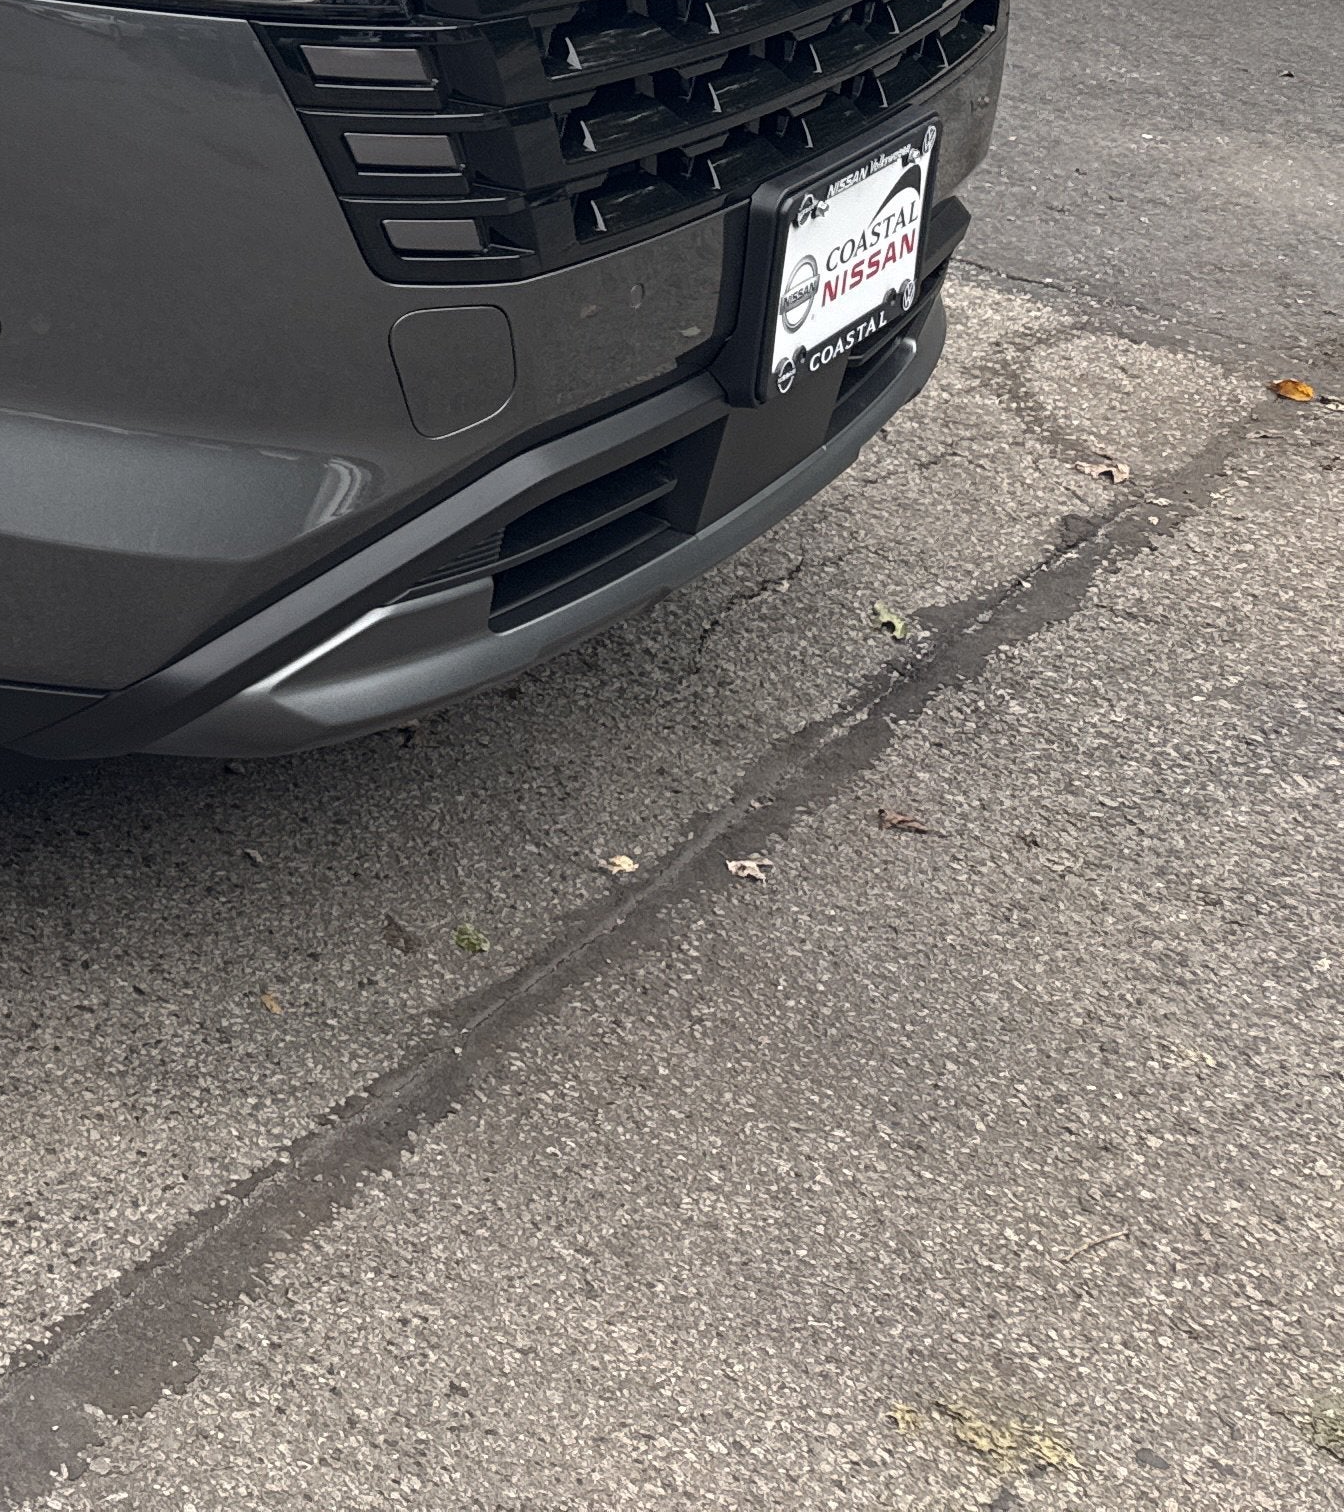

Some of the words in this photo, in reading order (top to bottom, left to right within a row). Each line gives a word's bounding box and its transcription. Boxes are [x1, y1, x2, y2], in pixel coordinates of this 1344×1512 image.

[826, 165, 868, 200] NISSAN
[825, 199, 919, 272] COASTAL
[782, 279, 818, 310] NISSAN
[821, 229, 916, 307] NISSAN
[809, 310, 888, 372] COASTAL
